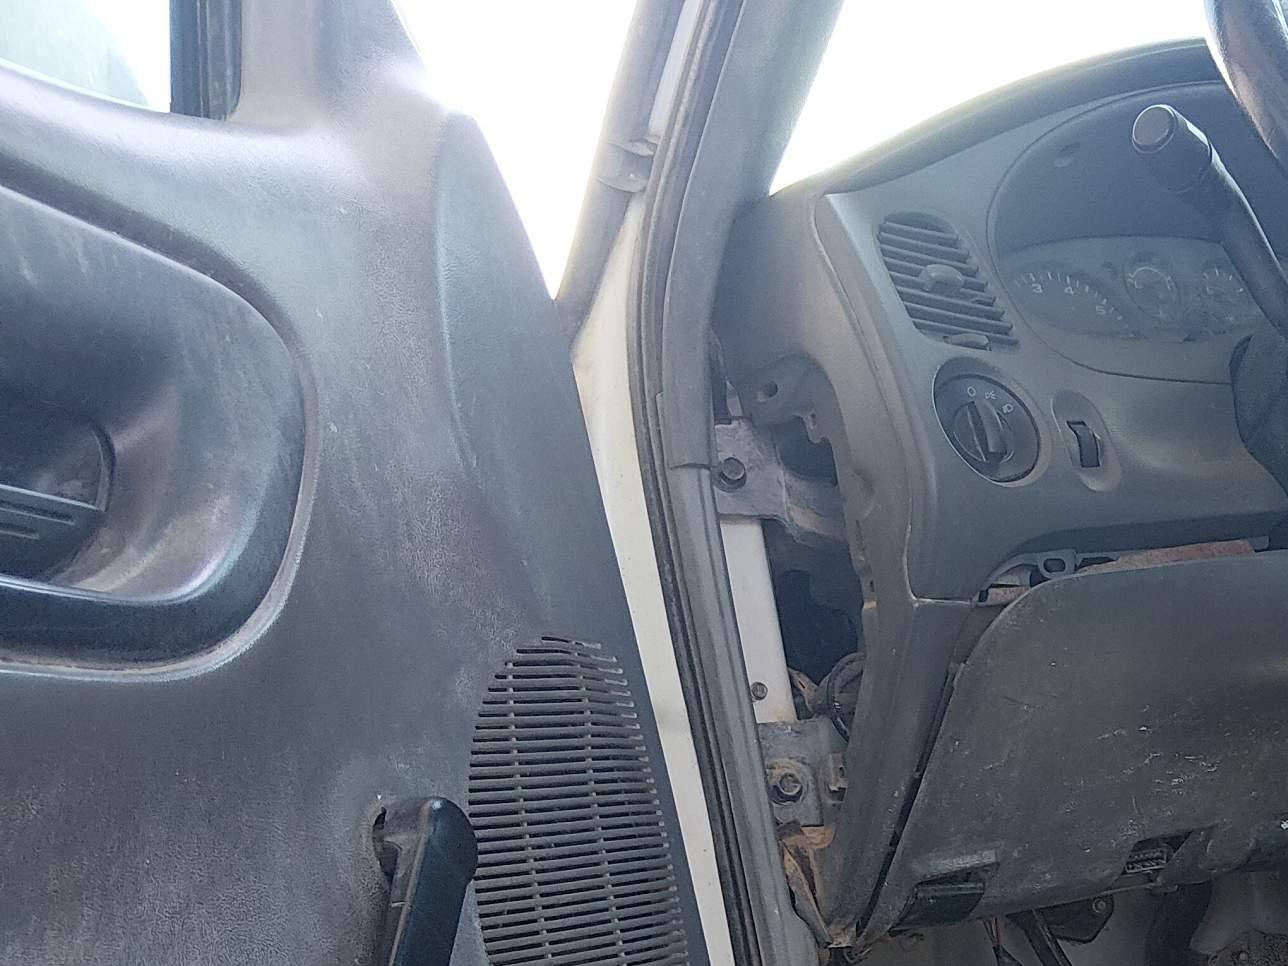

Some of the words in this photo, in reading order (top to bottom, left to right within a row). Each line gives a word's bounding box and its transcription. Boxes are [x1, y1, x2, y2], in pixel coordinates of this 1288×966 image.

[1032, 283, 1043, 294] 3
[1063, 285, 1075, 295] 4
[1095, 305, 1107, 316] 5
